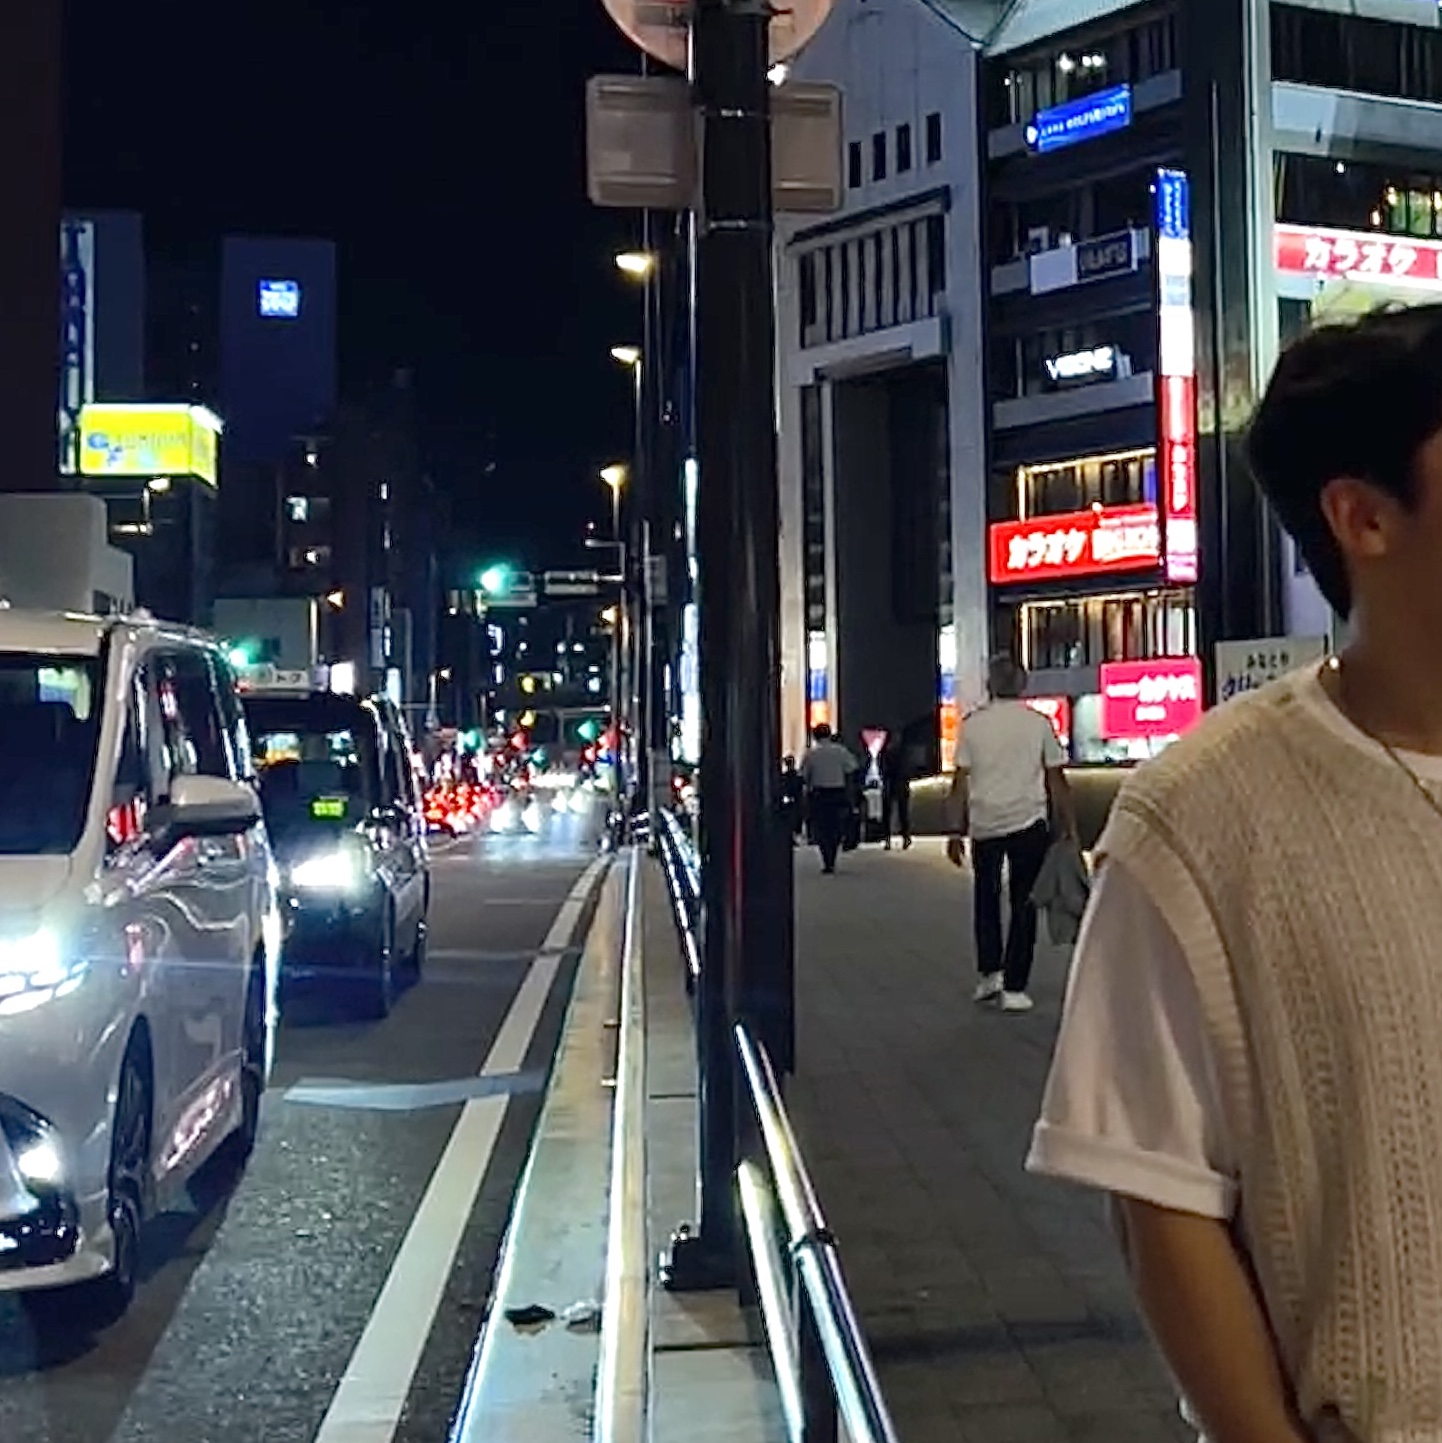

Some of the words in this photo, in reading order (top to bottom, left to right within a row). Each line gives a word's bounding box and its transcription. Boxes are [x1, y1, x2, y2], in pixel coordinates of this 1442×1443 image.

[1304, 236, 1417, 276] カラオケ
[1008, 528, 1087, 568] カラオケ
